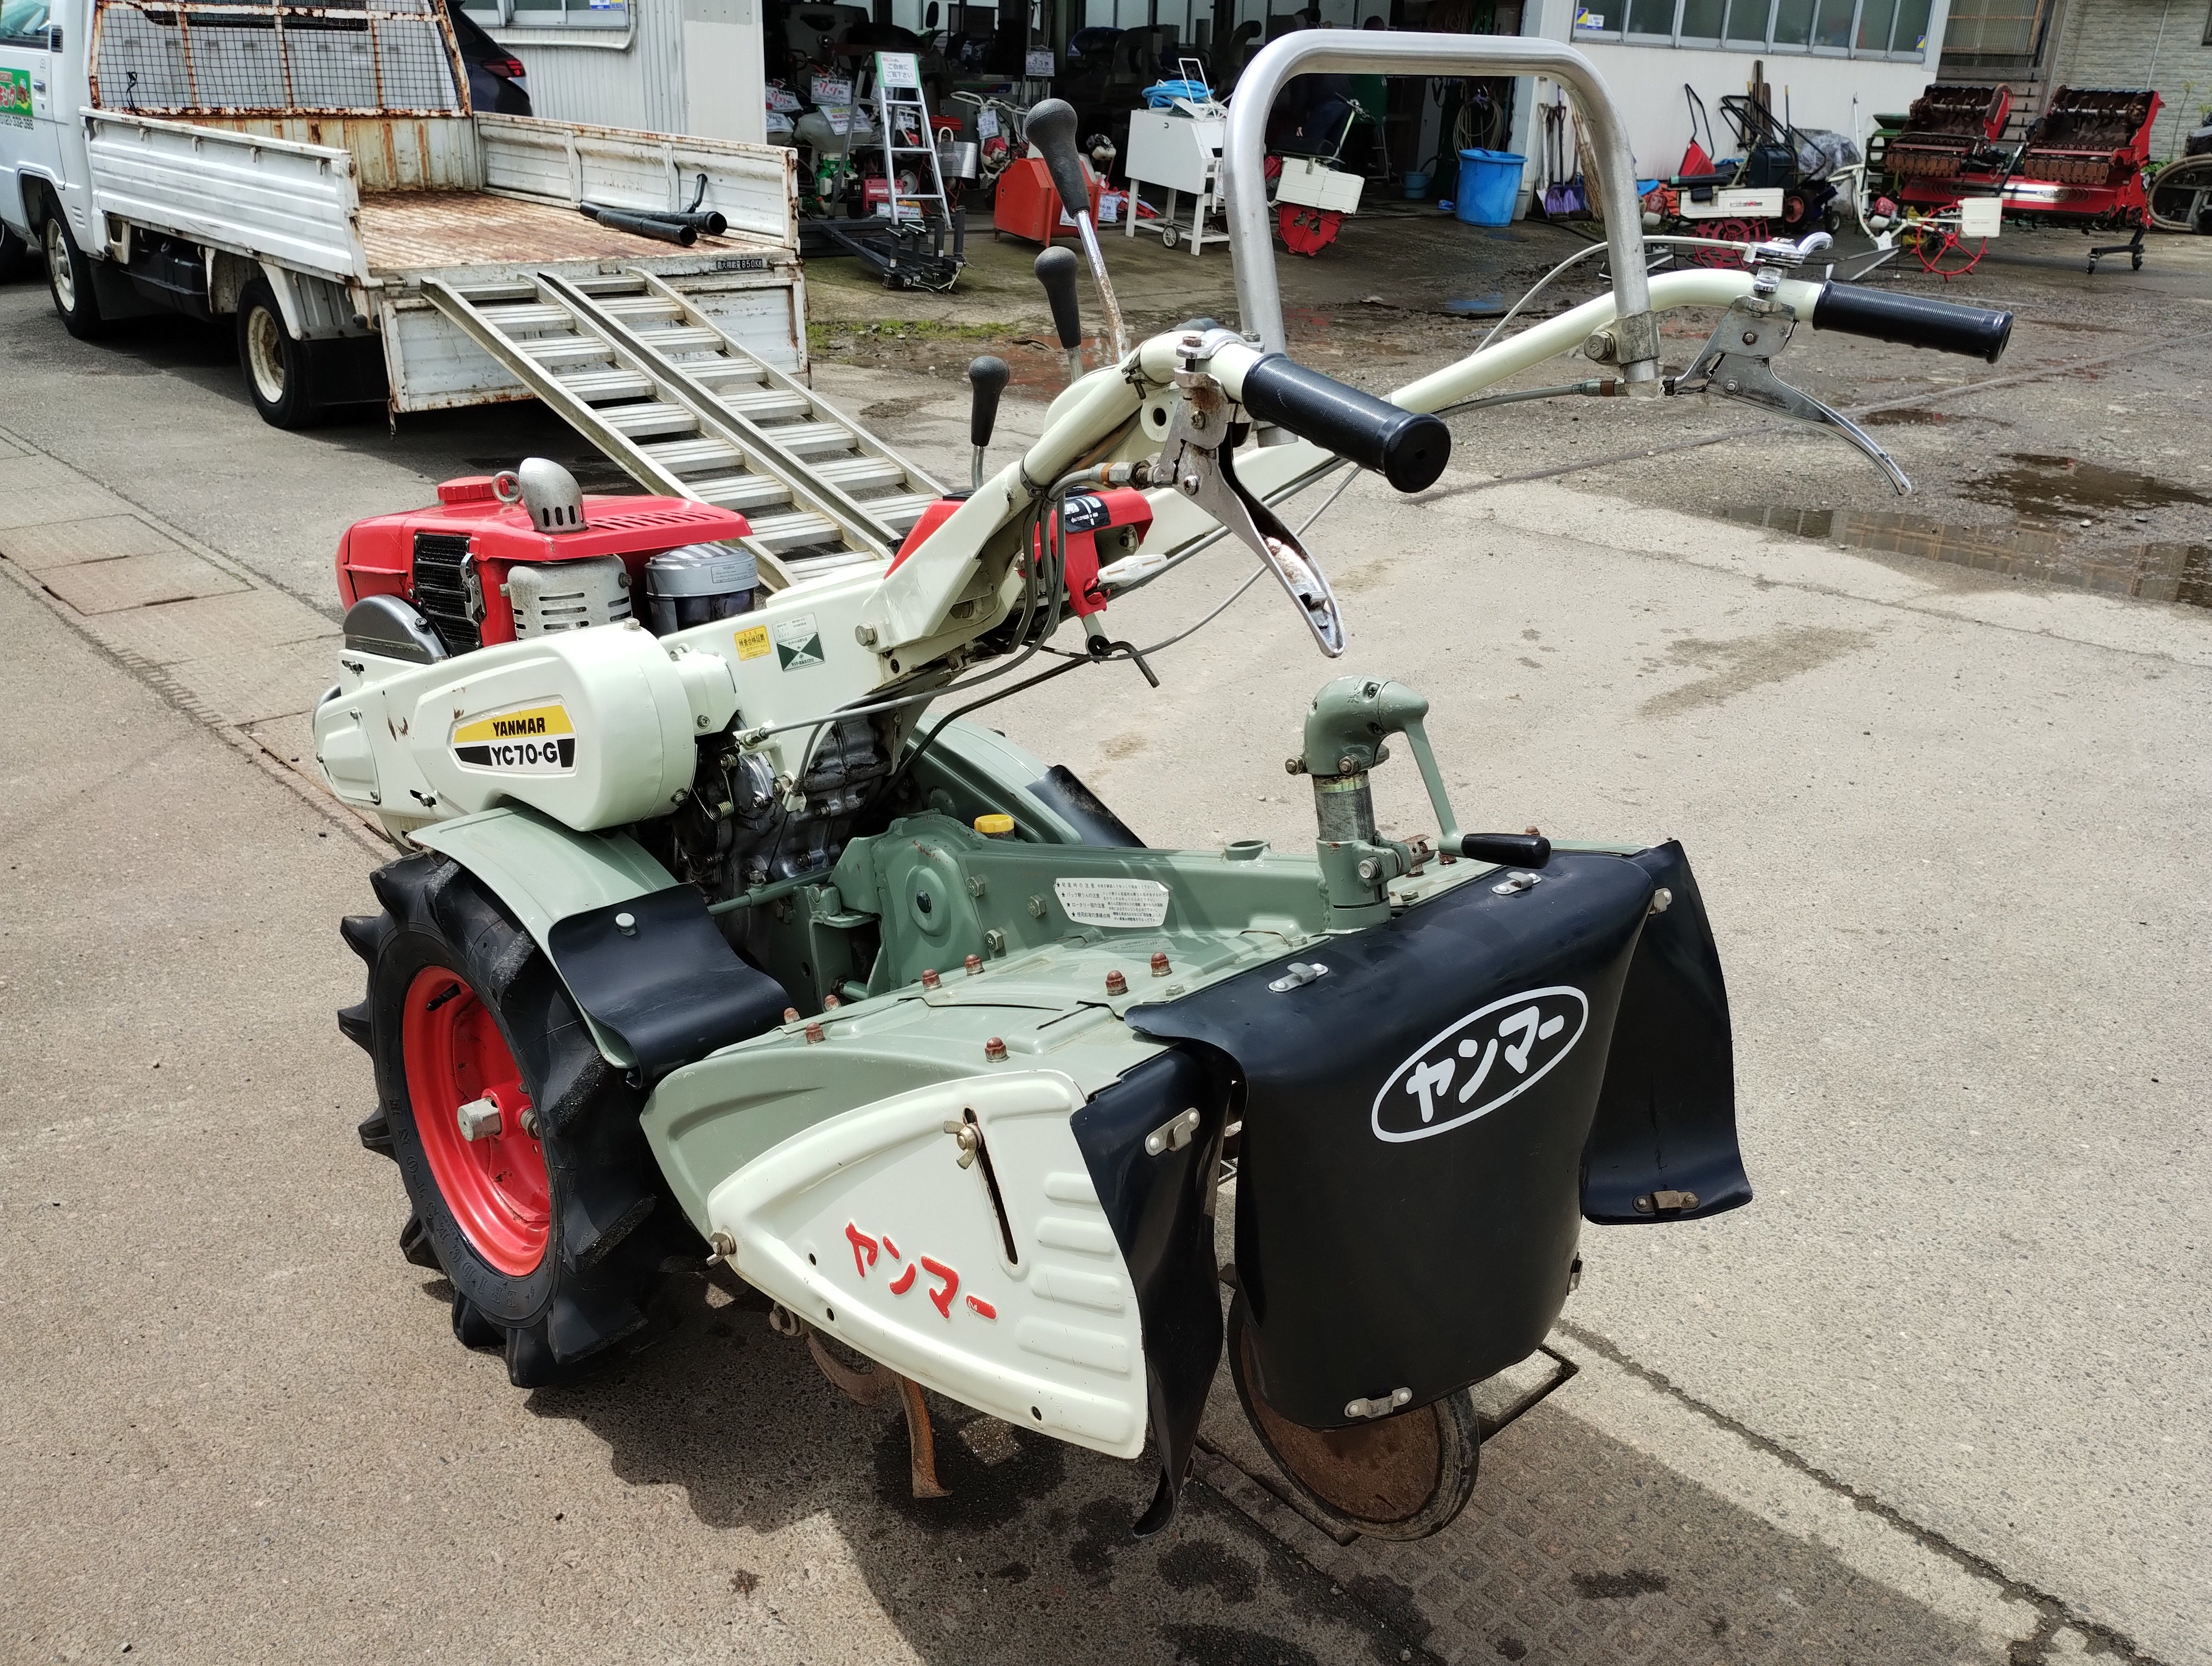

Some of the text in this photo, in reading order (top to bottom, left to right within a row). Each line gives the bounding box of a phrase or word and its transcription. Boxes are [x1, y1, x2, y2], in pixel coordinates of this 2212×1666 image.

[491, 742, 558, 766] YC70-G
[493, 717, 546, 736] YANMAR
[1406, 1006, 1564, 1123] ヤンマー
[845, 1221, 997, 1320] ヤンマー
